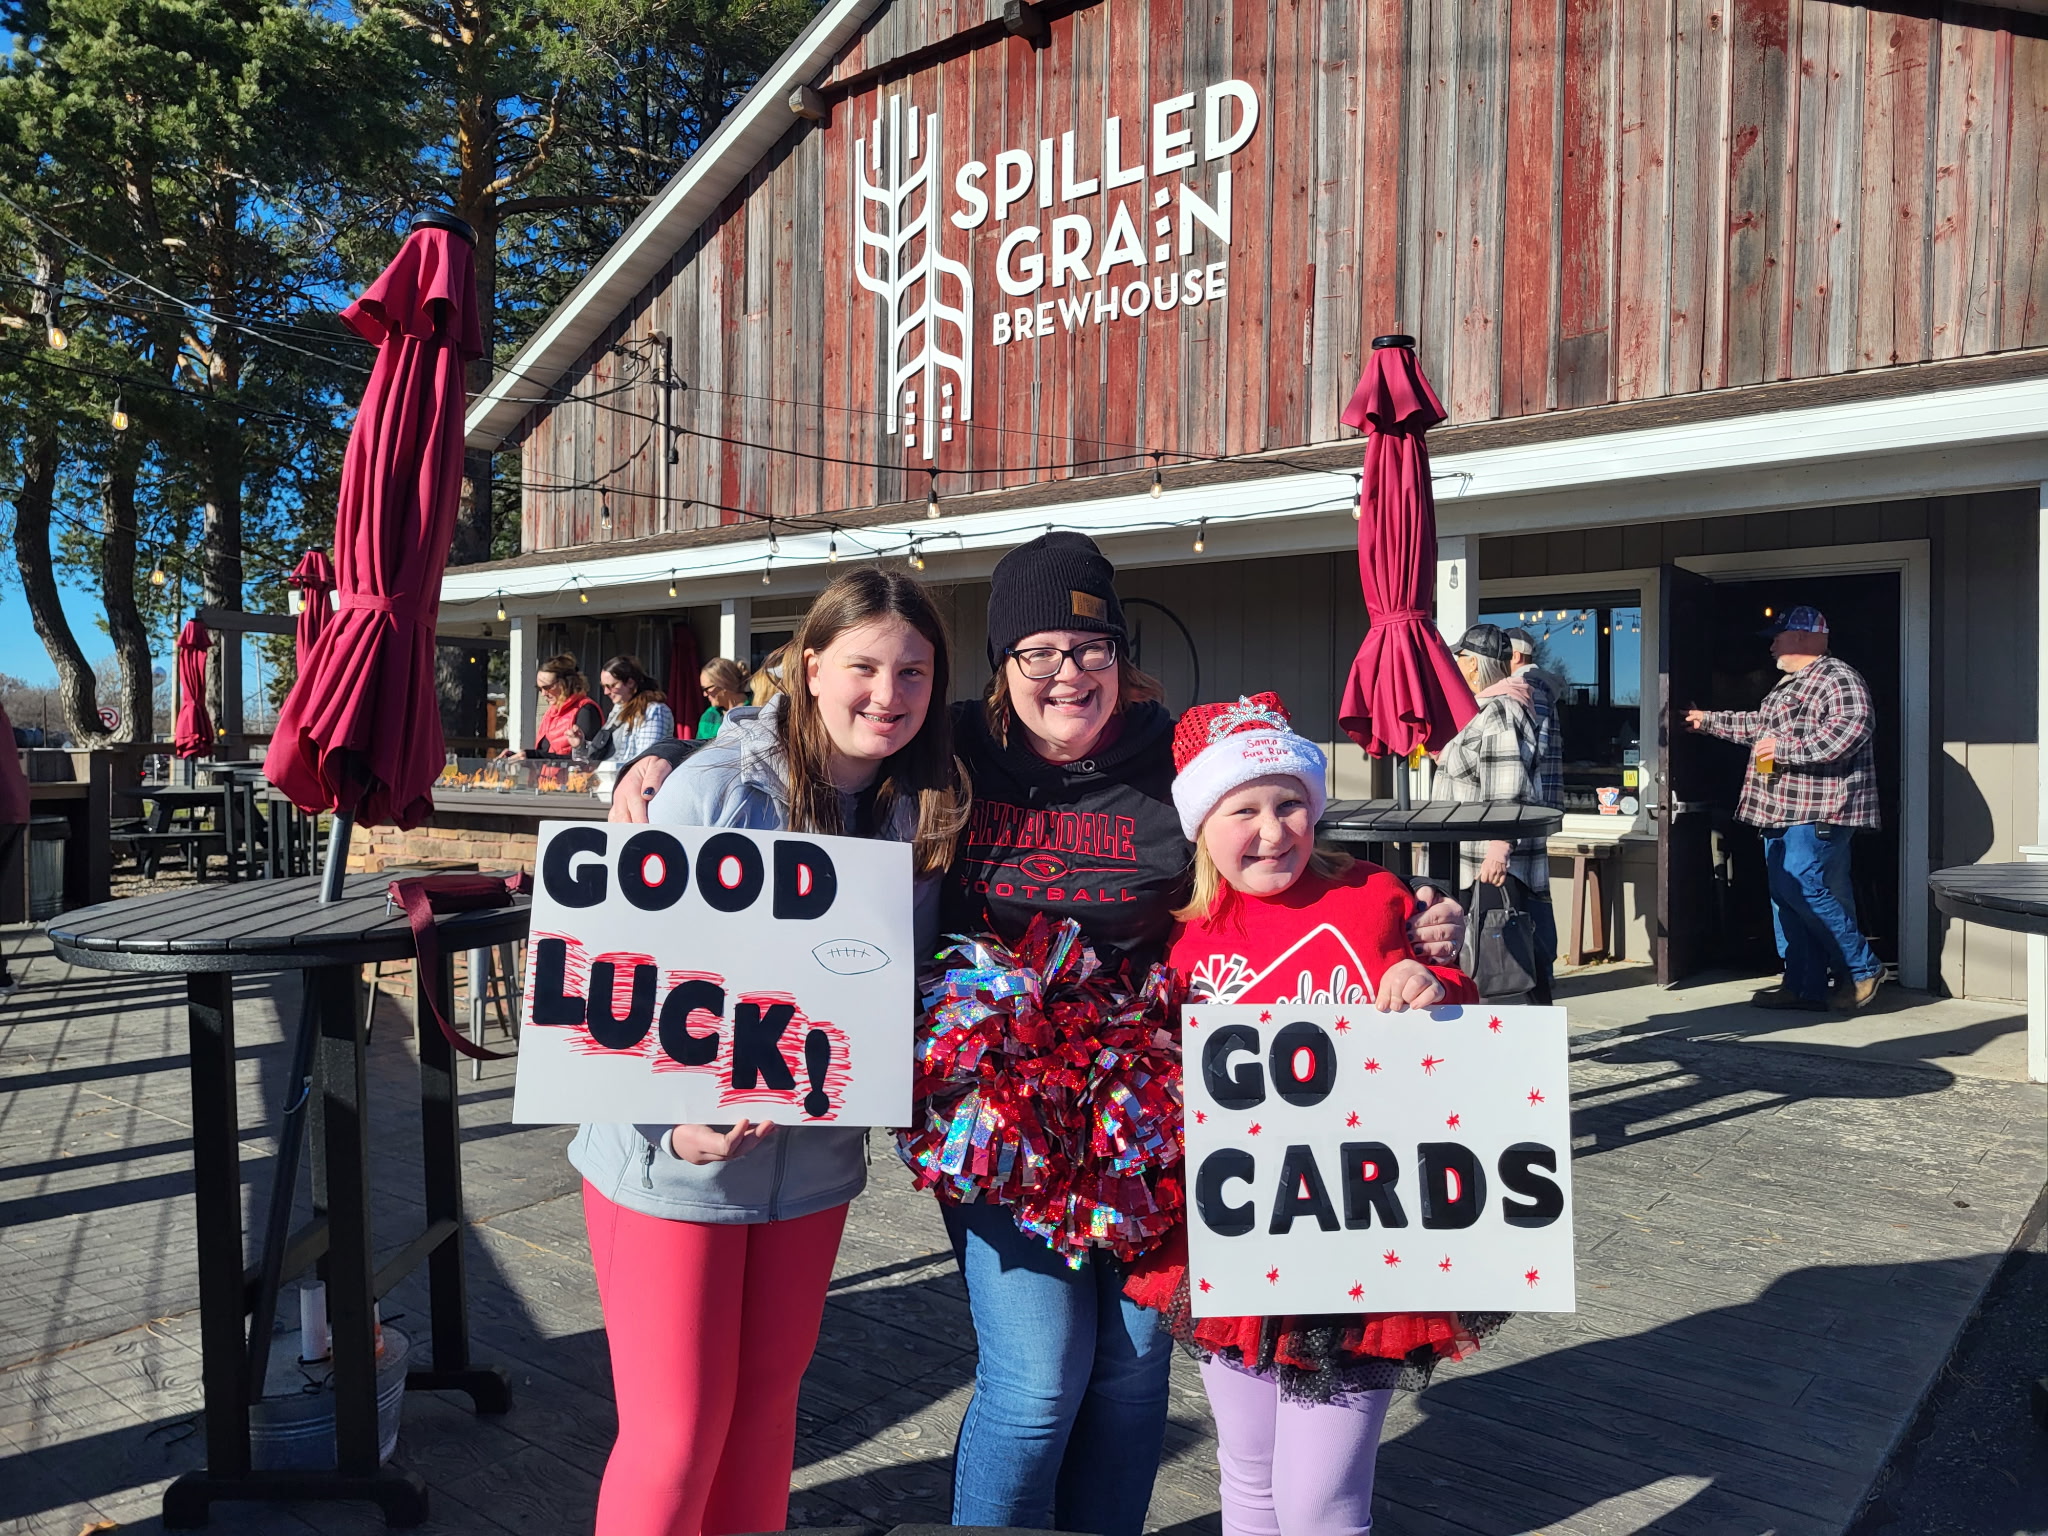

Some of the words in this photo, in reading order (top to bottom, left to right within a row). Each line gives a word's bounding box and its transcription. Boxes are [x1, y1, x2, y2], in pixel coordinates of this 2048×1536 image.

[951, 80, 1259, 229] SPILLED
[996, 170, 1232, 296] GRAIN
[993, 261, 1227, 345] BREWHOUSE
[543, 826, 838, 920] GOOD
[532, 938, 831, 1118] LUCK!
[1277, 965, 1368, 1004] dale
[1202, 1021, 1337, 1111] GO
[1195, 1141, 1564, 1237] CARDS
